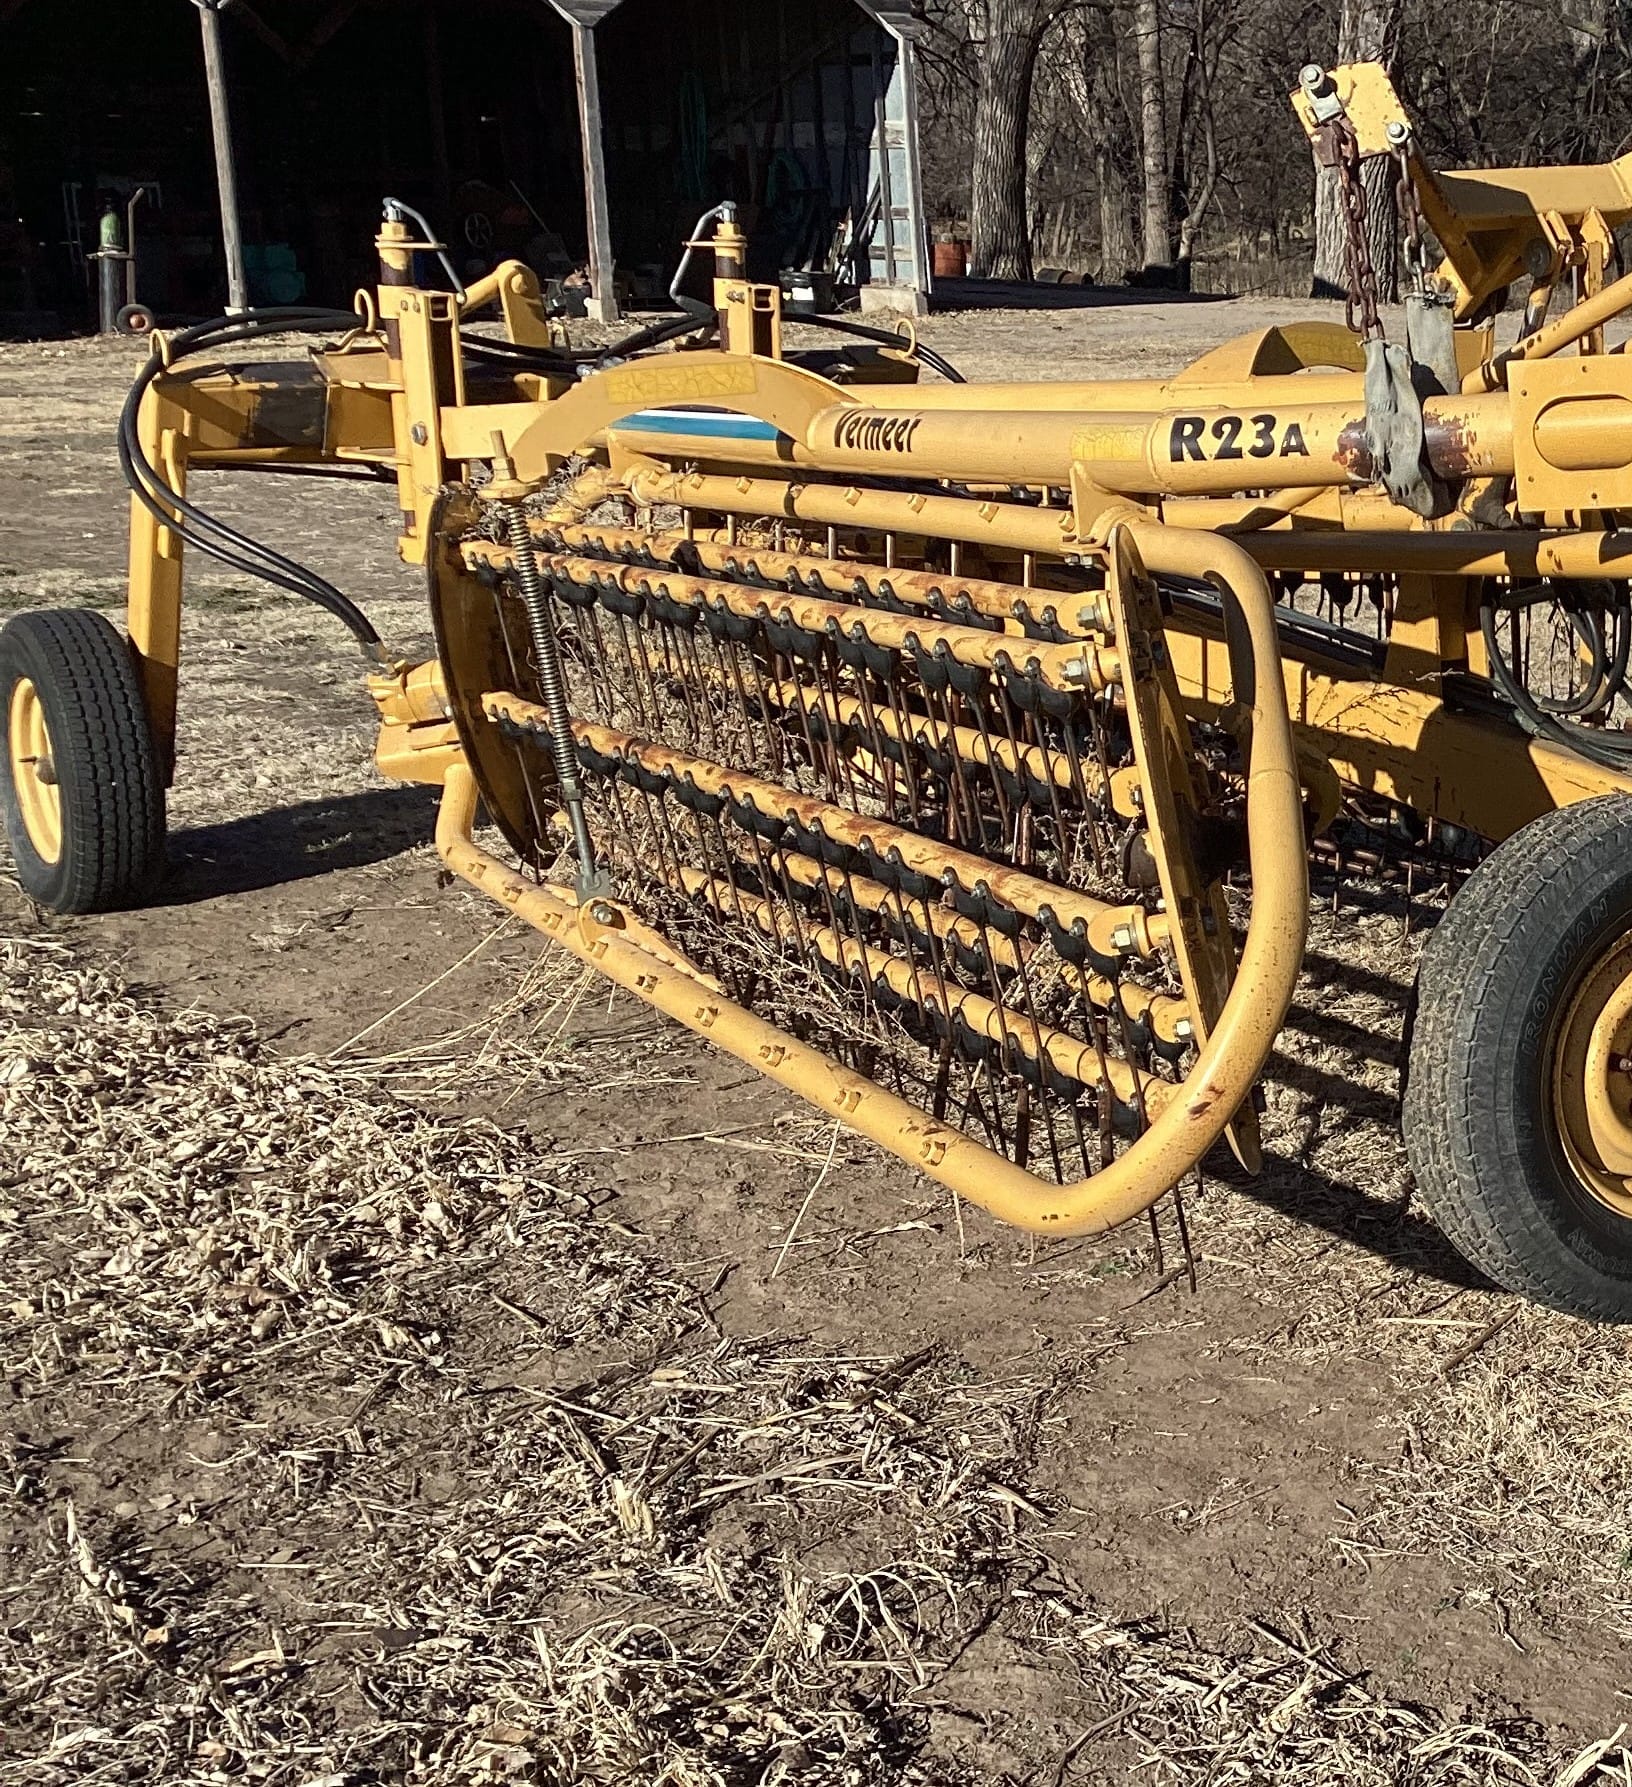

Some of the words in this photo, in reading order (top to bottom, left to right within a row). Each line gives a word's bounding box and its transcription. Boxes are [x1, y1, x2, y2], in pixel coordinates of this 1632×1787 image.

[834, 408, 923, 453] Vermeer
[1169, 413, 1311, 463] R23A
[1521, 897, 1610, 1057] IRONMAN
